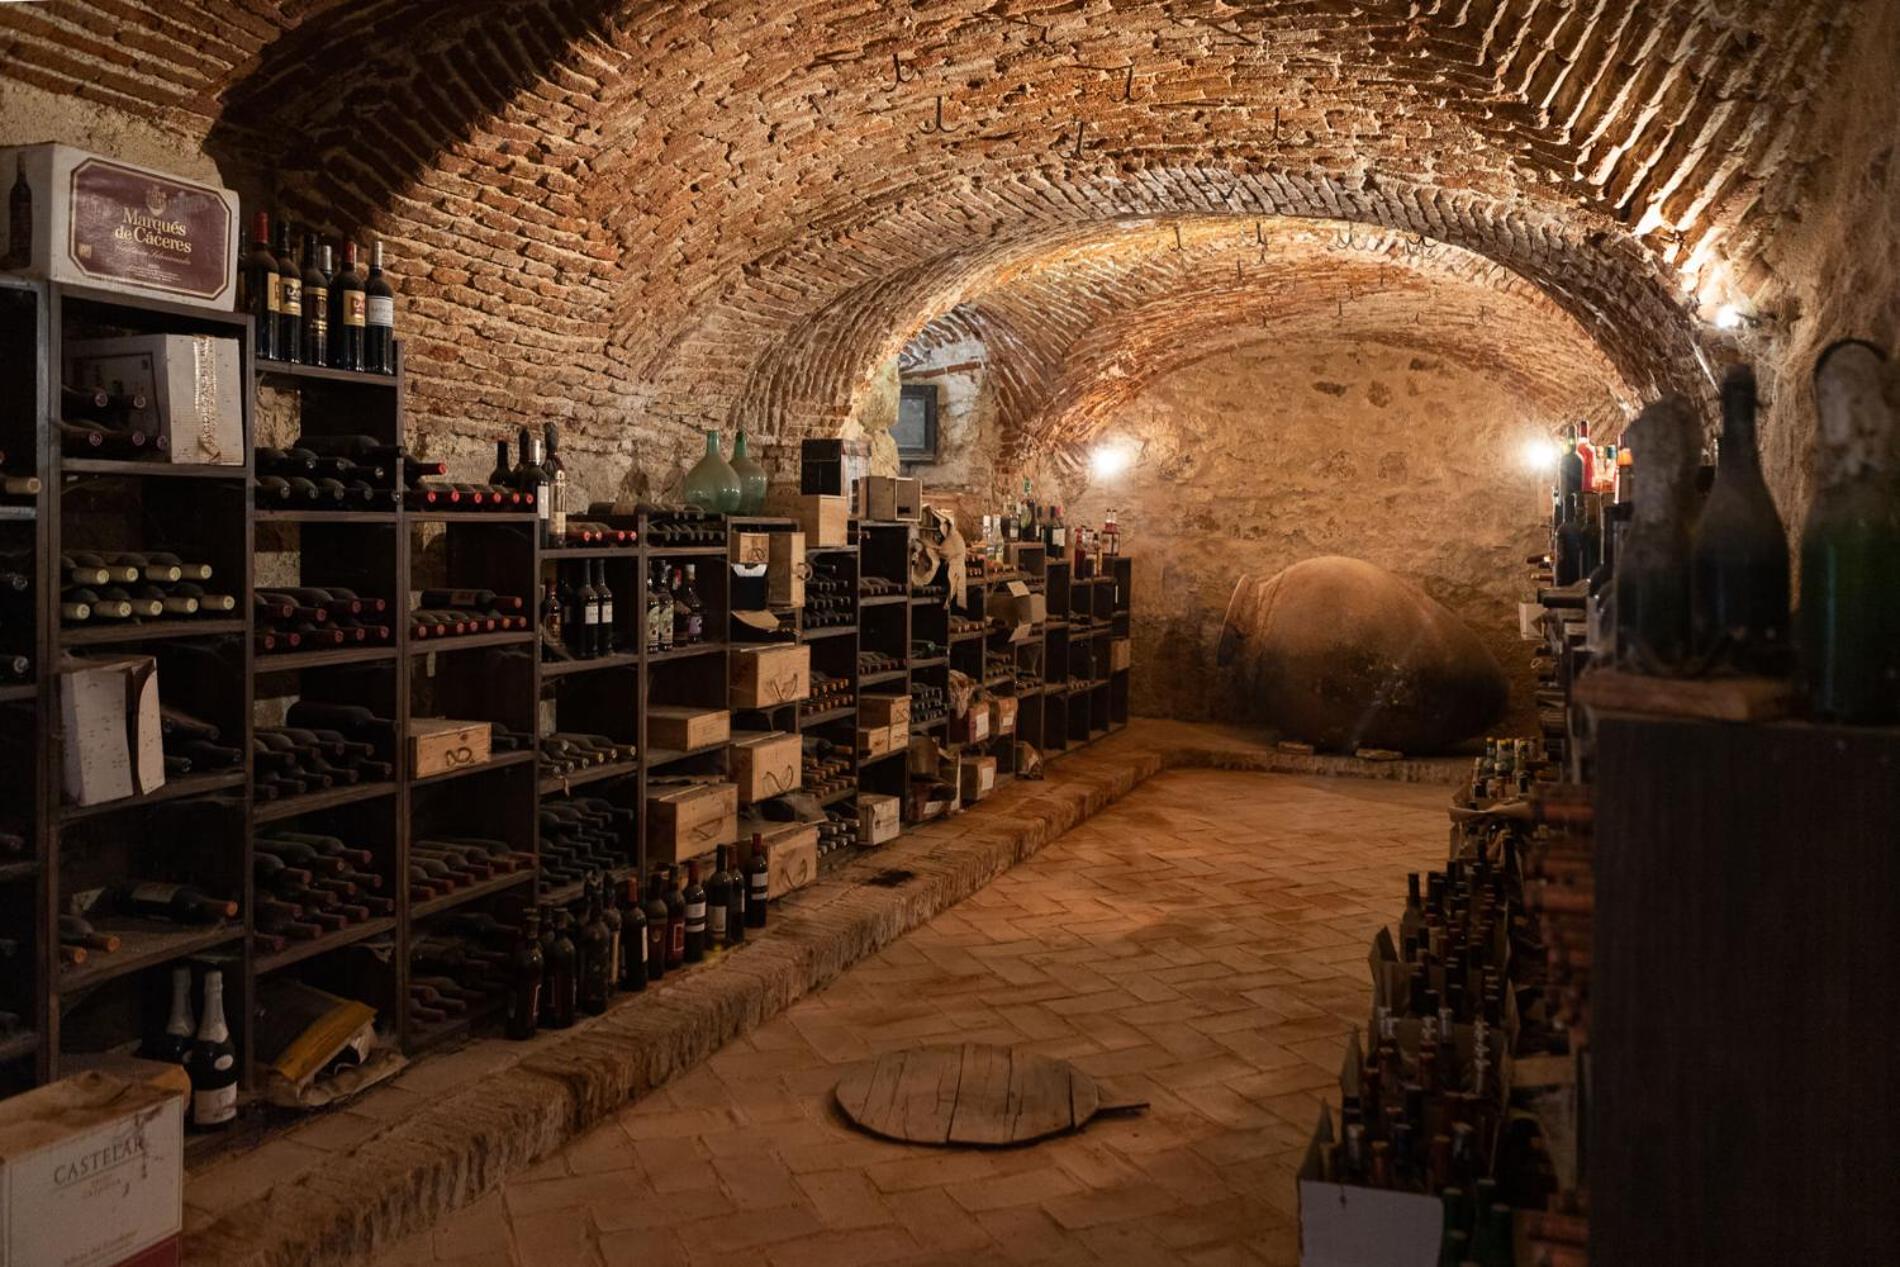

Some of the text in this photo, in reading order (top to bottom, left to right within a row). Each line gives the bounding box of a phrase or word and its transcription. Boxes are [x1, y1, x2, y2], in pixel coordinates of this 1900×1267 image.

[122, 206, 187, 236] Marqués
[114, 224, 132, 241] de
[133, 226, 192, 253] Cáceres
